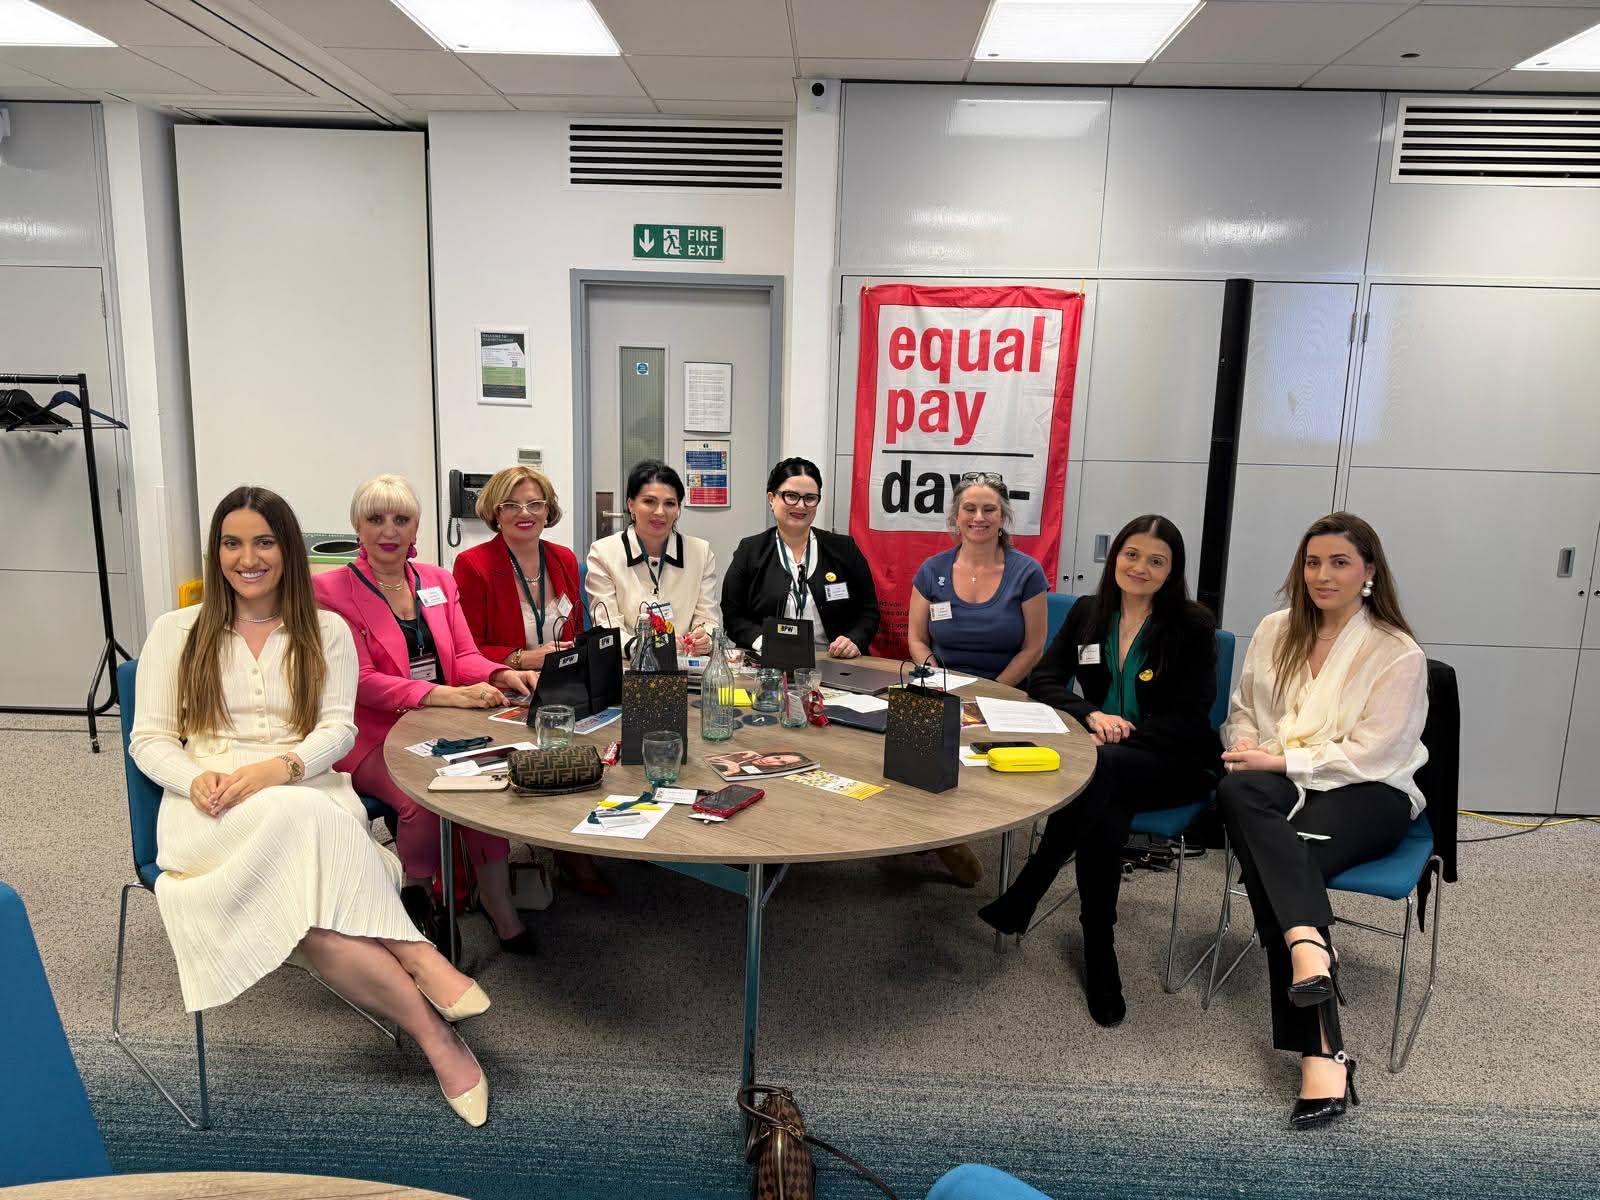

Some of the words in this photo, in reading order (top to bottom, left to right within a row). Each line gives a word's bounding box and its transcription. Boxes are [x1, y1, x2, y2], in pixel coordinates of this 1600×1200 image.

[687, 229, 718, 242] FIRE
[687, 244, 718, 257] EXIT
[888, 316, 1046, 384] equal
[885, 388, 987, 446] pay
[881, 459, 962, 514] da
